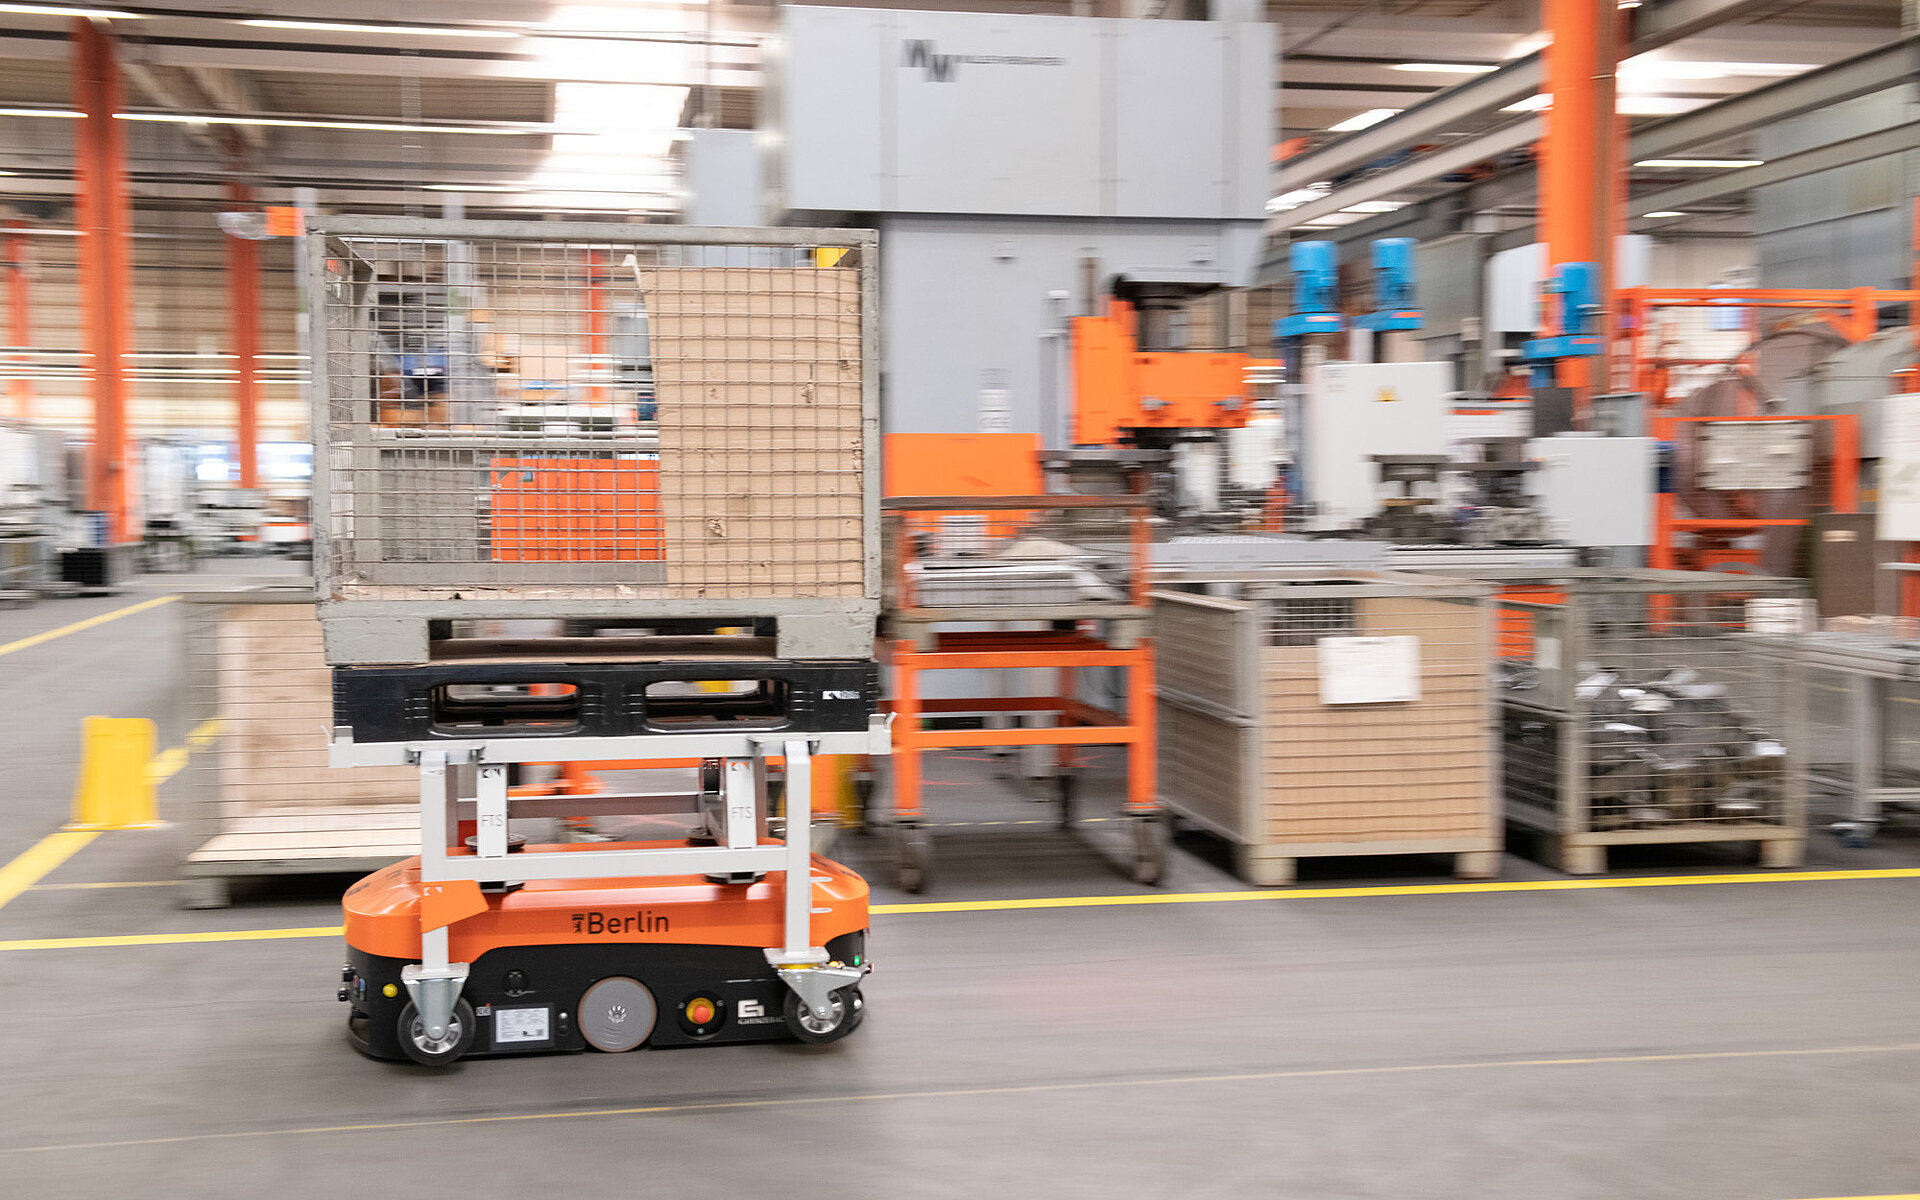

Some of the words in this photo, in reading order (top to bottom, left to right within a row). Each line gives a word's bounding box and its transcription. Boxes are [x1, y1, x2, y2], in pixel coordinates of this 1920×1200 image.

[731, 806, 752, 819] FTS
[480, 813, 503, 827] FTS
[588, 911, 669, 935] Berlin
